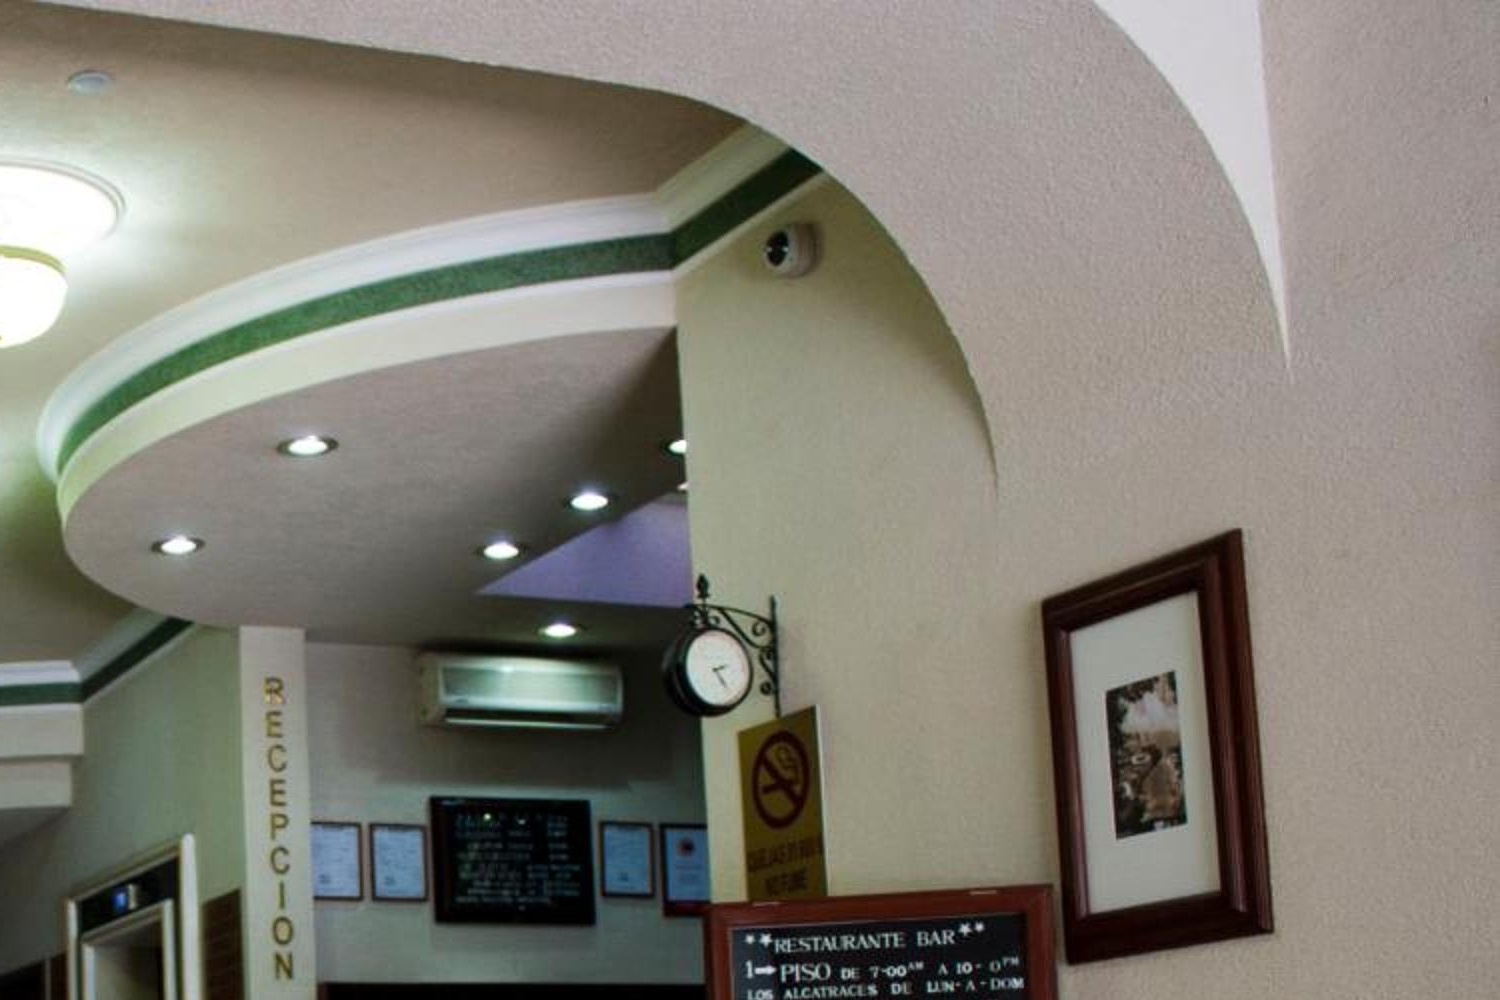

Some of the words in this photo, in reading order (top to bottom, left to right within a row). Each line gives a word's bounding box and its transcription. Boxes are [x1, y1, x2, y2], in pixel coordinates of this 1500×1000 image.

[264, 677, 295, 981] RECEPCION
[774, 931, 906, 954] RESTAURANTE
[916, 928, 955, 947] BAR
[780, 963, 831, 983] PISO
[840, 967, 860, 980] DE
[747, 989, 774, 1000] LOS
